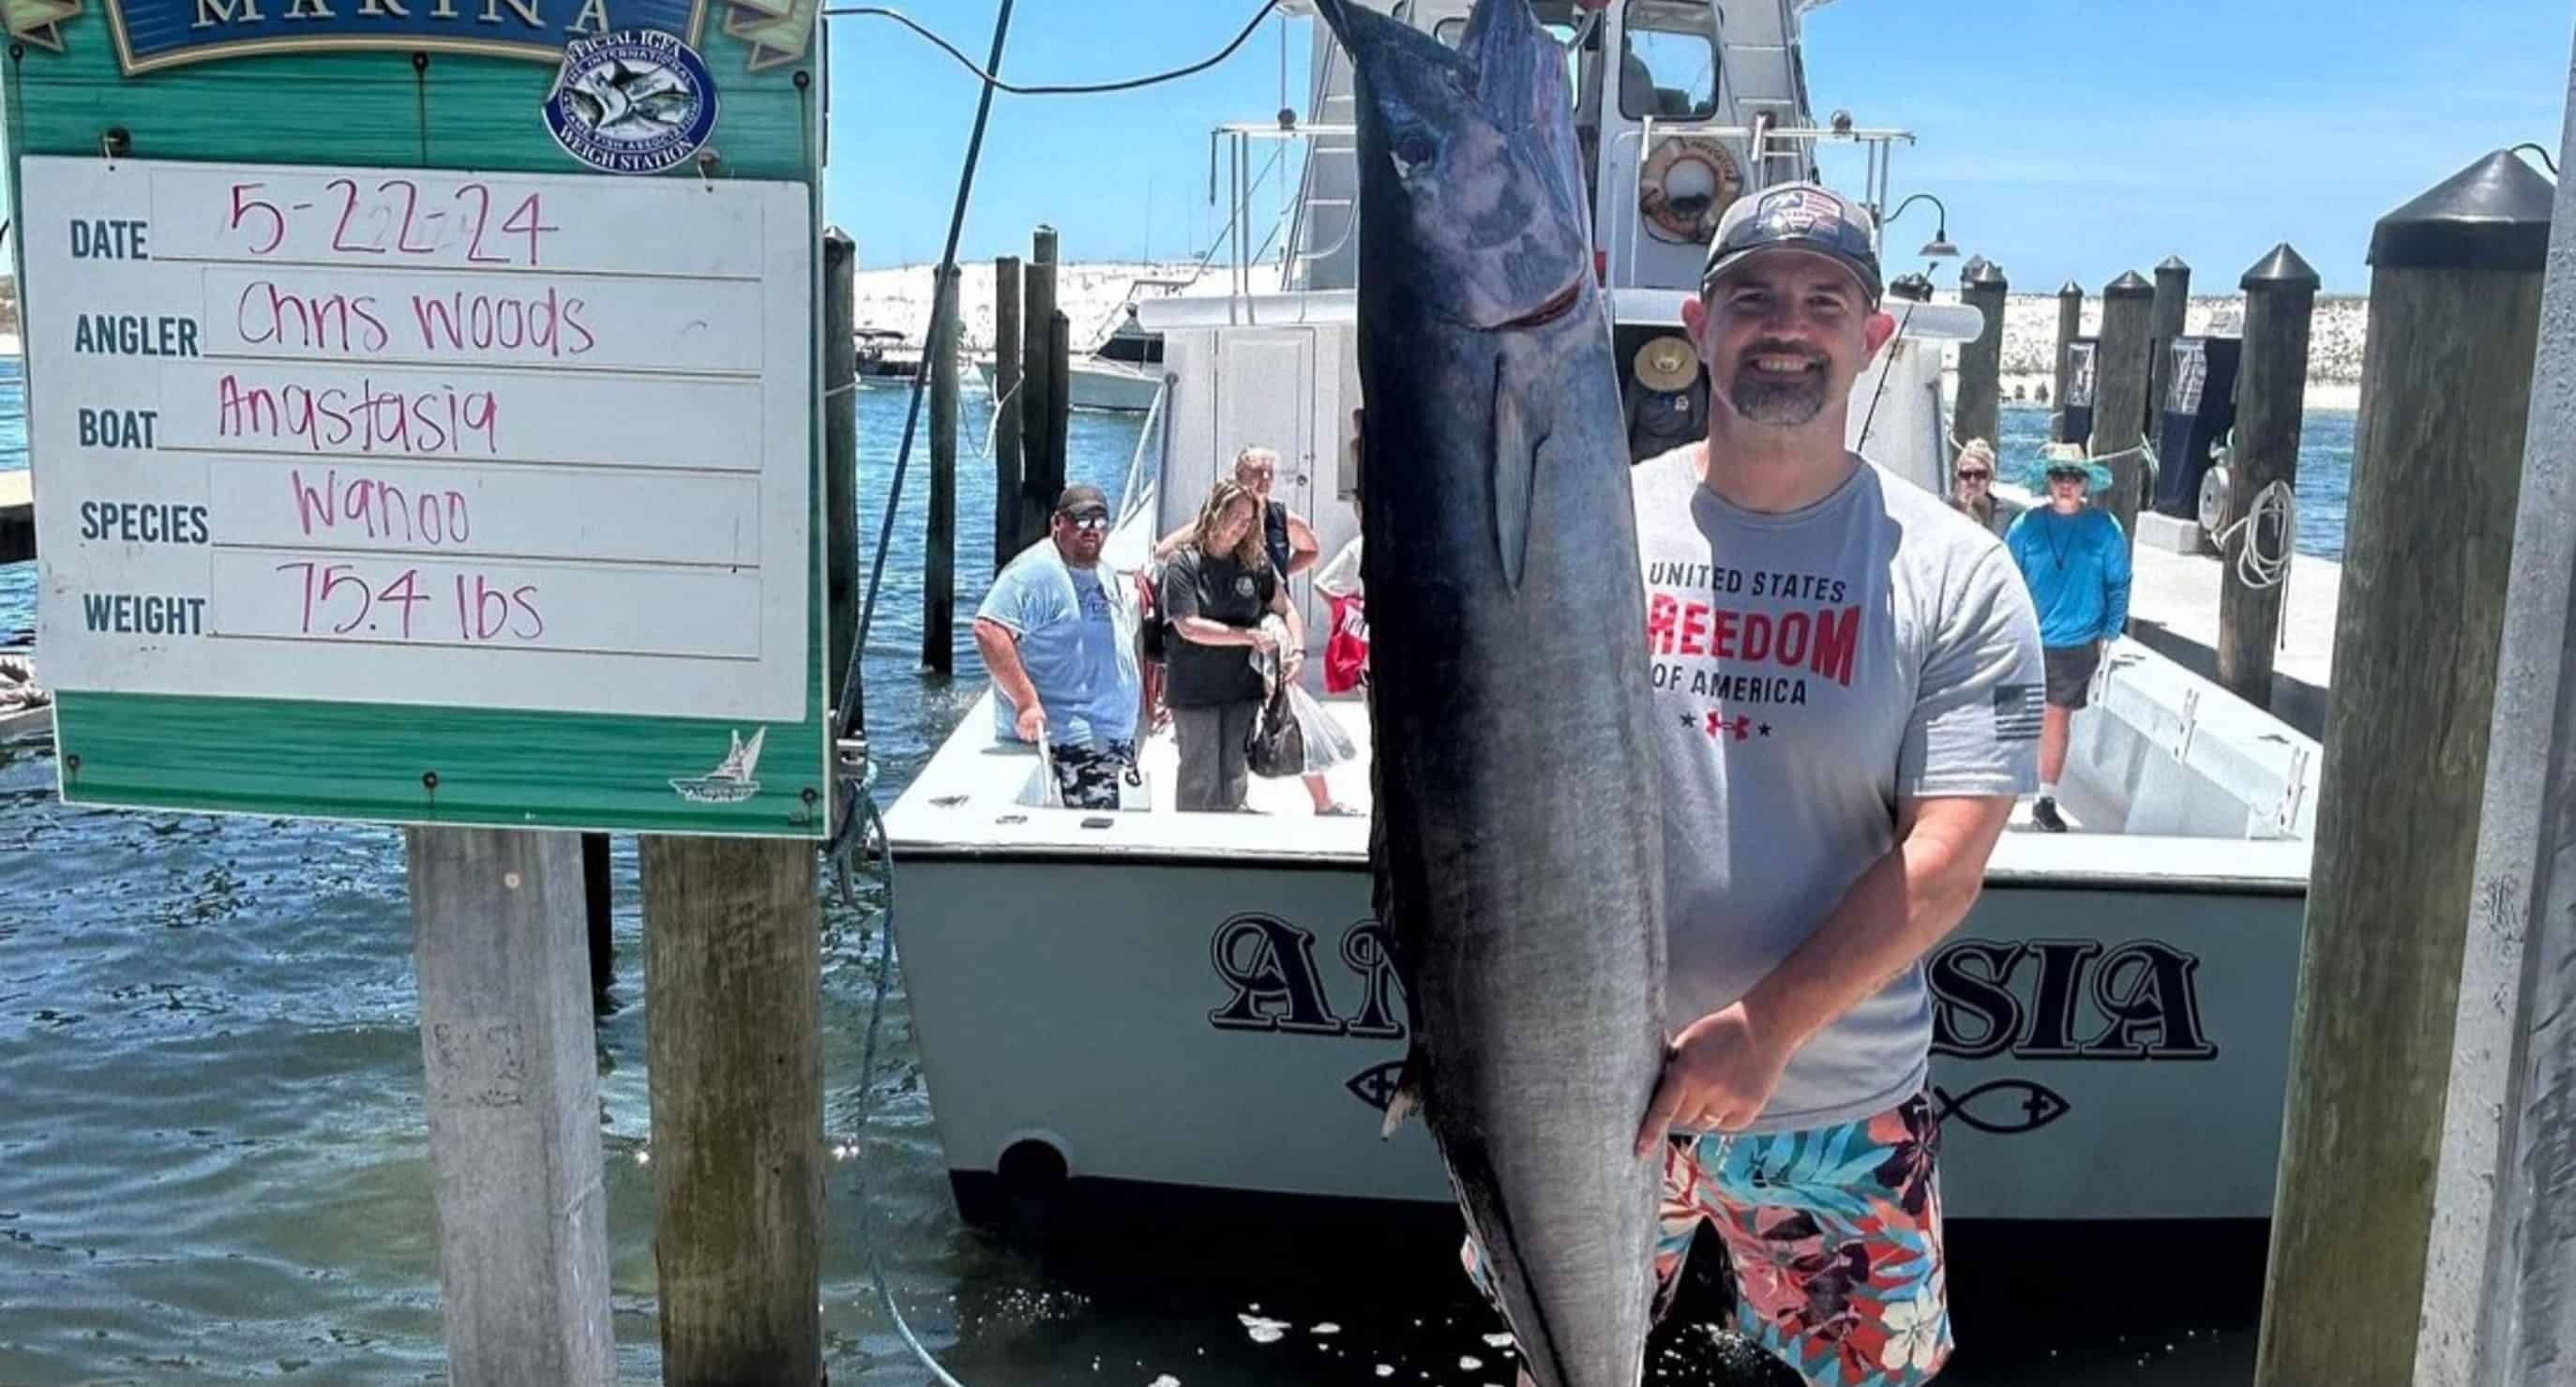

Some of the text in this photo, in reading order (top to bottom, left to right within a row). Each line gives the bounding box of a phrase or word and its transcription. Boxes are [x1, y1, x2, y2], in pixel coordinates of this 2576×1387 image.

[566, 29, 680, 64] FFICIAL IGFA
[560, 125, 694, 170] WEIGH STATION
[70, 219, 148, 260] DATE
[231, 178, 560, 266] 5-22-24
[74, 314, 199, 356] ANGLER
[79, 408, 158, 449] BOAT
[219, 375, 497, 454] Anastasia
[81, 502, 209, 544] SPECIES
[276, 563, 430, 639] 75.4
[1649, 562, 1846, 603] UNITED STATES
[83, 594, 205, 635] WEIGHT
[1647, 593, 1861, 688] REEDOM
[1651, 662, 1807, 705] OF AMERICA
